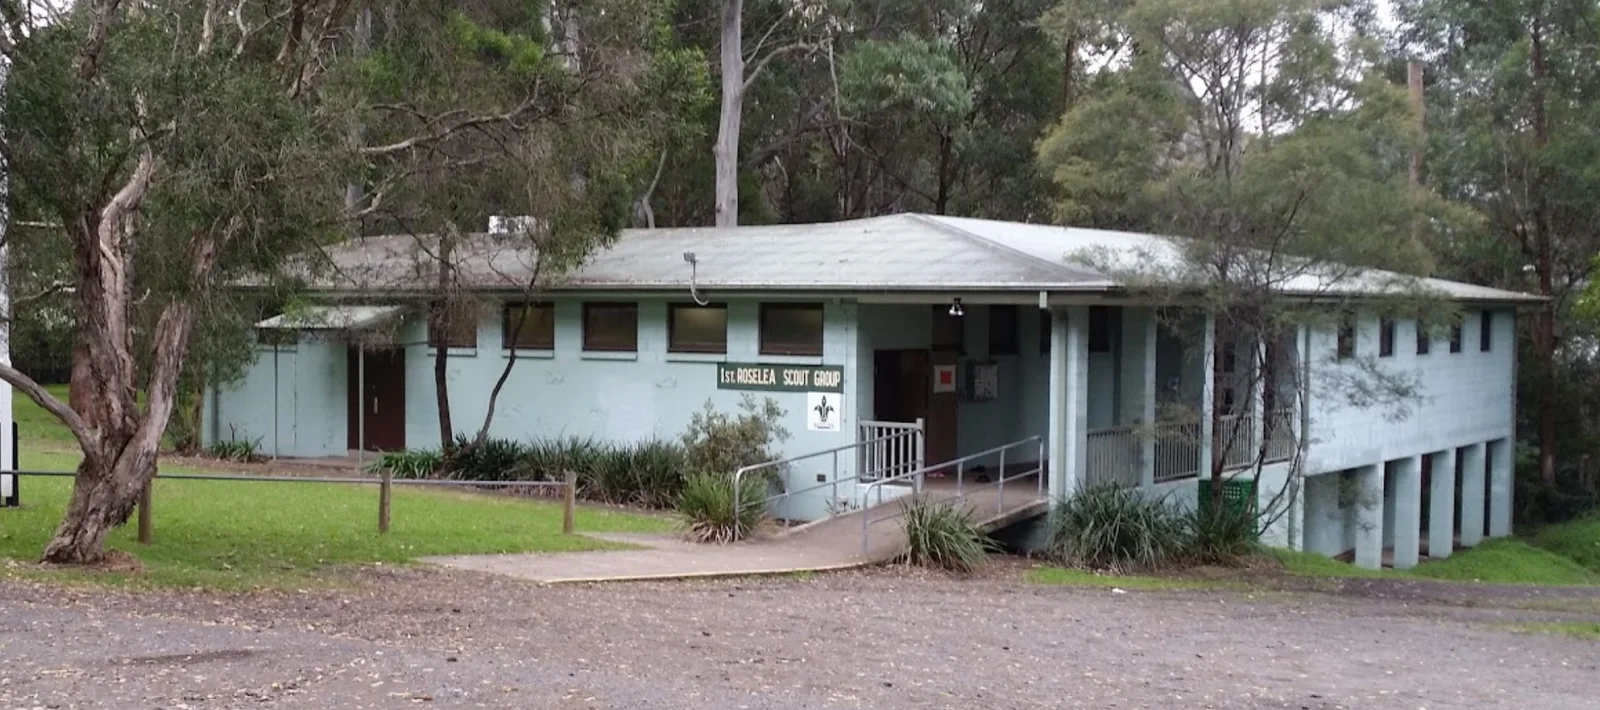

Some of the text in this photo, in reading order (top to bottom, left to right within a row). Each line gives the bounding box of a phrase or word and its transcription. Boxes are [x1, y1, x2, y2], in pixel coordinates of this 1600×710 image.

[737, 367, 776, 385] ROSELEA
[783, 369, 810, 386] SCOUT
[814, 370, 840, 388] GROUP
